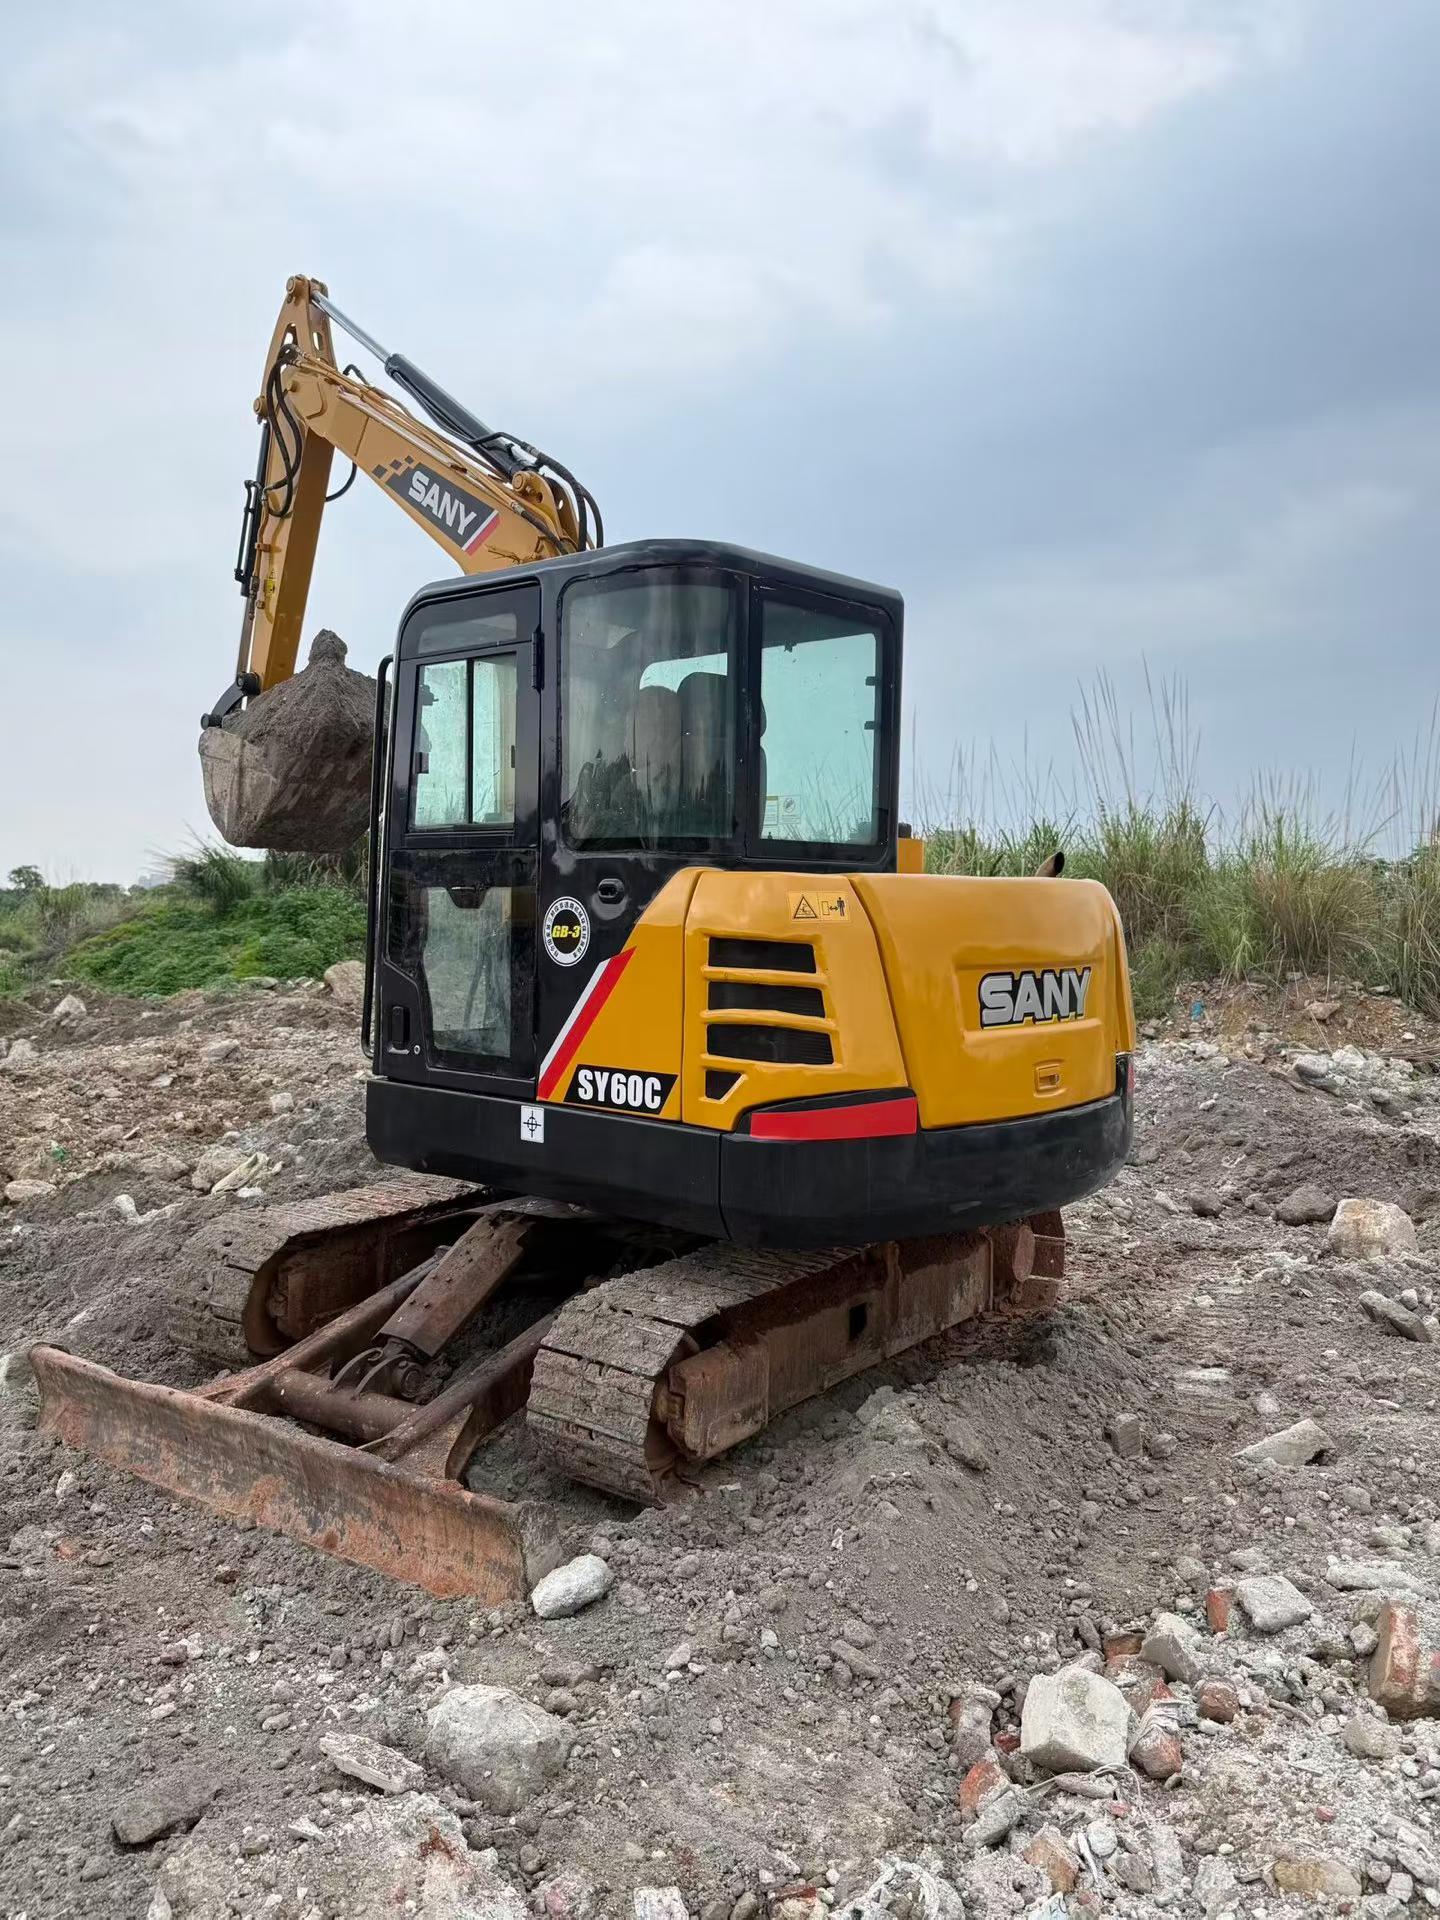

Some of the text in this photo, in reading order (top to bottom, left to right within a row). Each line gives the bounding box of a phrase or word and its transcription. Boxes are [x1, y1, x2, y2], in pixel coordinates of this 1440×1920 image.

[408, 470, 477, 536] SANY
[552, 925, 581, 938] GB-3
[979, 968, 1091, 1026] SANY
[578, 1069, 661, 1109] SY60C
